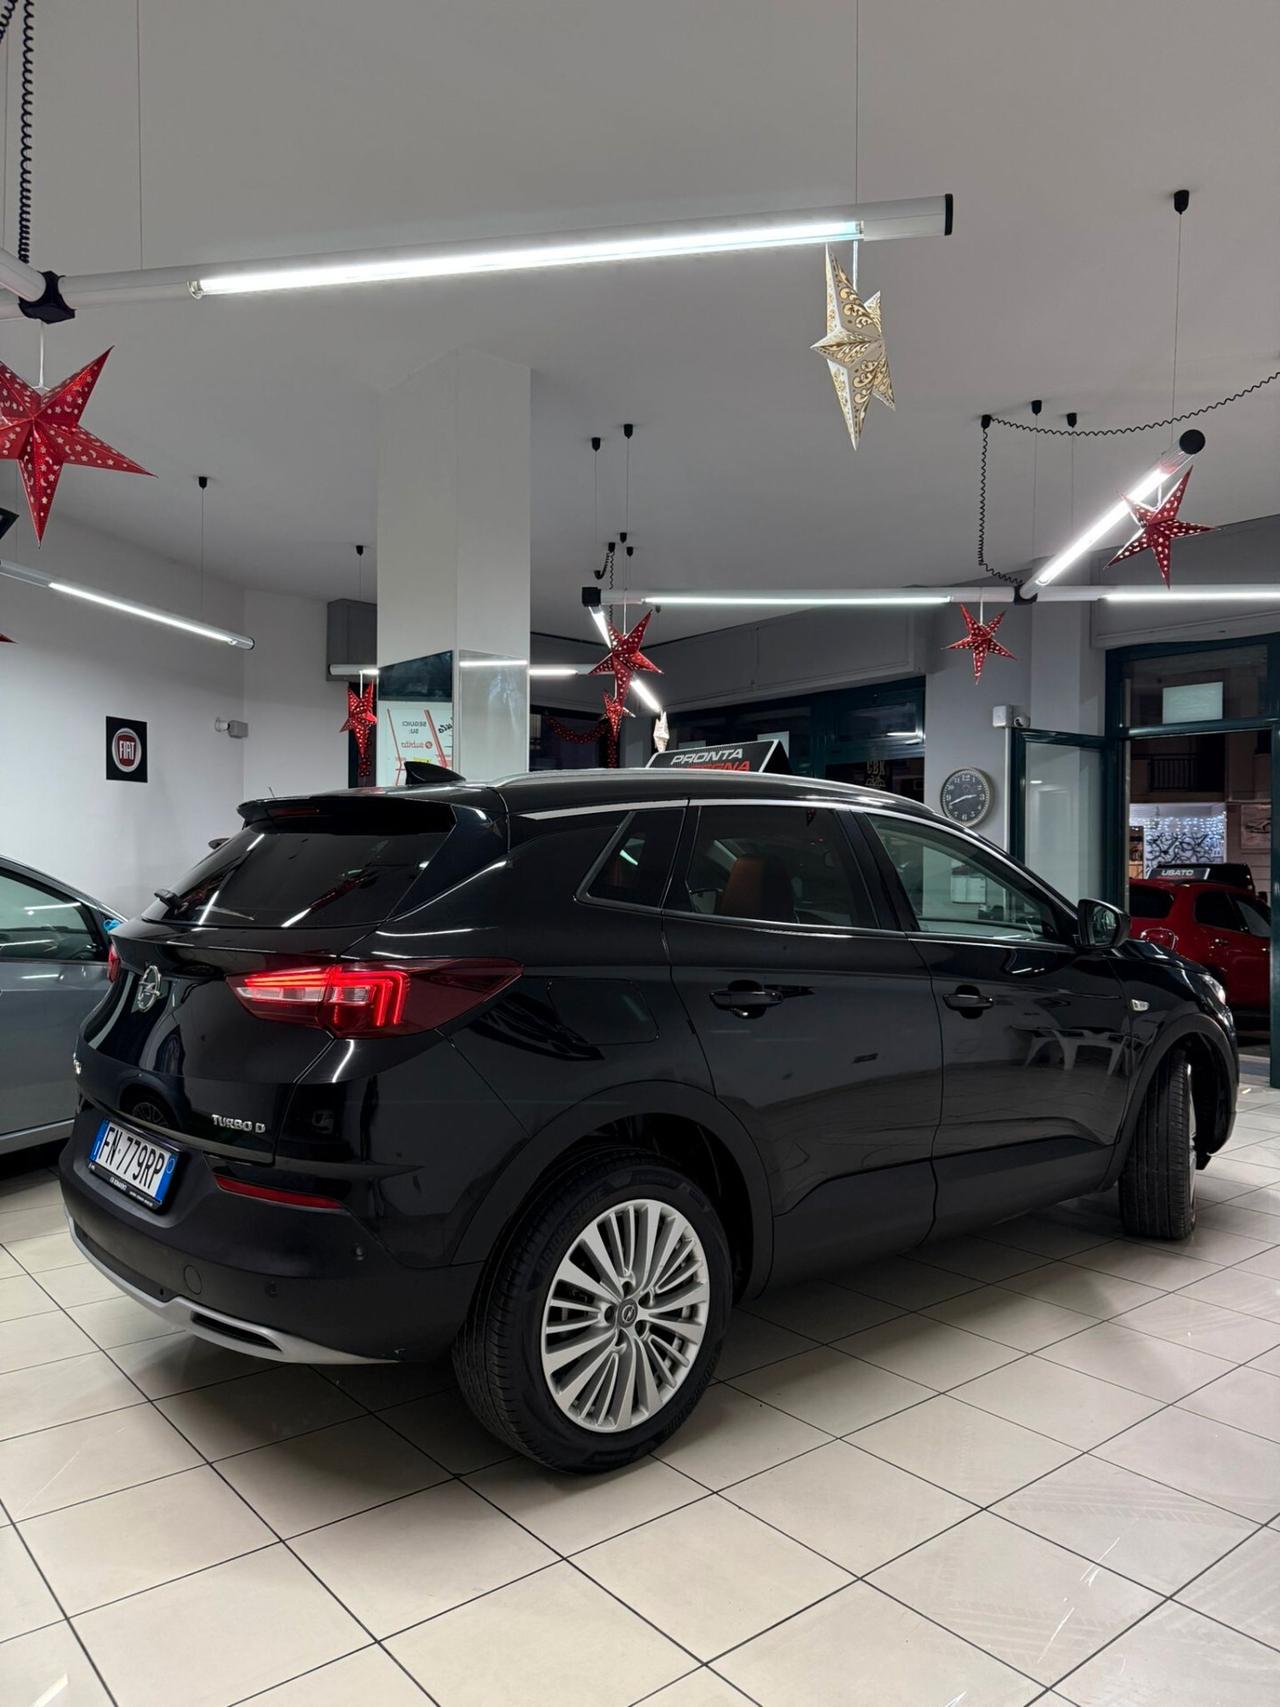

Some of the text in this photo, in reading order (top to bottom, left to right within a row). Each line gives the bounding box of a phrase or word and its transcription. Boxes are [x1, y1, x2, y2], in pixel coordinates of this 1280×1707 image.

[119, 740, 136, 760] FIAT
[670, 748, 743, 765] PRONTA
[211, 1114, 266, 1133] TURBO D
